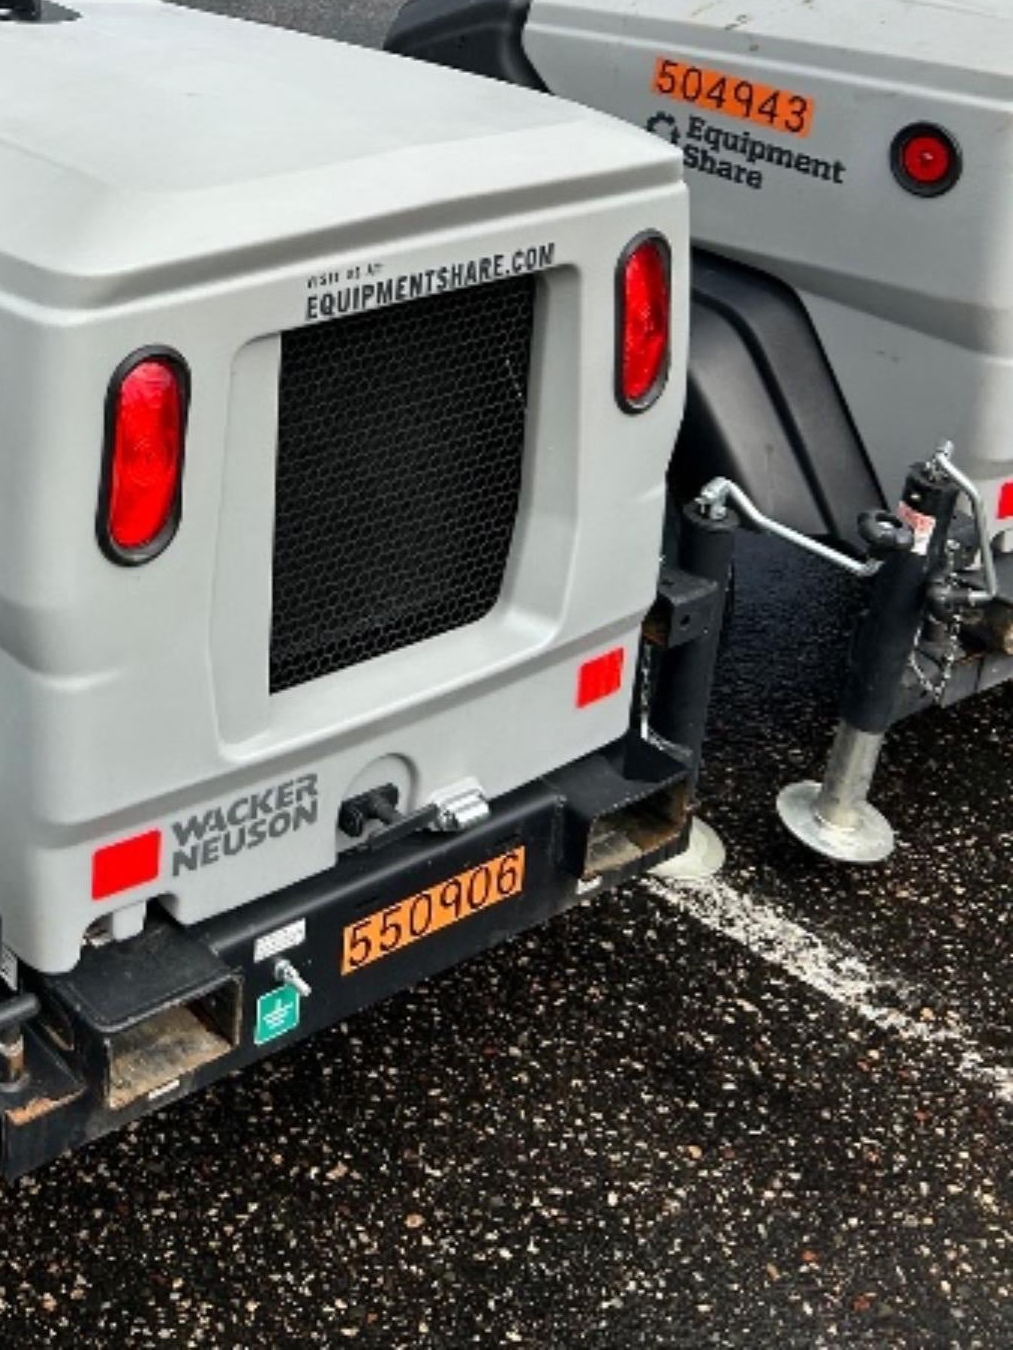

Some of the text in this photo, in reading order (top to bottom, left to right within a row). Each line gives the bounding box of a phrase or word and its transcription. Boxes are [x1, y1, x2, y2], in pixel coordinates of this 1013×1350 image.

[655, 58, 808, 133] 504943
[683, 143, 763, 190] Share
[686, 113, 846, 185] Equipment
[305, 242, 556, 321] EQUIPMENTSHARE.COM
[172, 773, 318, 846] WACKER
[172, 798, 318, 877] NEUSON
[348, 853, 520, 967] 550906
